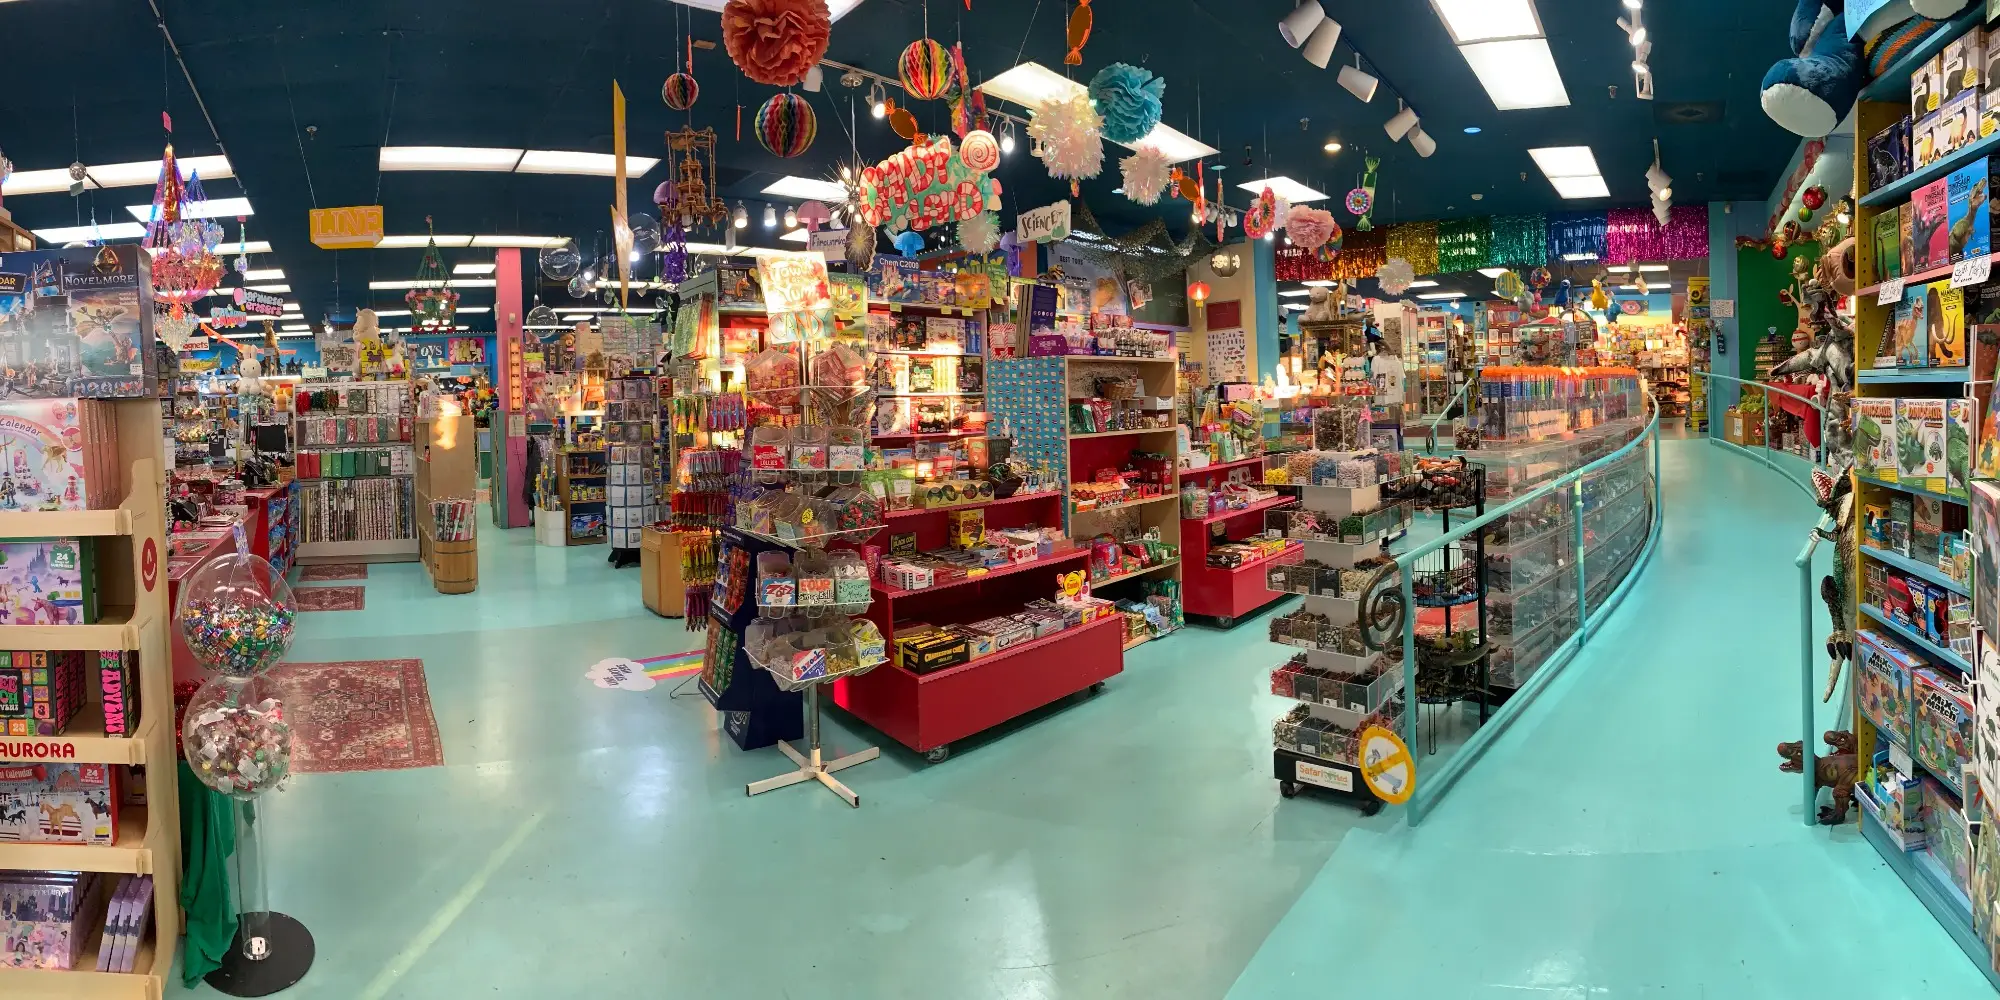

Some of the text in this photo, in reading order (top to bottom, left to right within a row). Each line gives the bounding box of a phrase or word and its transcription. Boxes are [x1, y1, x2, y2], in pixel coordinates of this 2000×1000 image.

[860, 135, 952, 227] CANDY
[910, 179, 984, 231] LAND
[313, 208, 381, 237] LINE
[1020, 209, 1058, 239] SCIENCE
[878, 257, 920, 270] Chem C2000
[1060, 255, 1071, 263] BEST
[65, 274, 136, 287] NOVELMORE
[768, 310, 836, 341] CANDY
[182, 341, 209, 351] agnets
[1908, 406, 1944, 422] DINOSAUR
[56, 552, 69, 561] 24
[1871, 650, 1888, 665] Mix
[1868, 656, 1891, 678] Match
[1931, 692, 1952, 709] Mix
[1926, 699, 1957, 722] Match
[0, 742, 75, 758] AURORA
[6, 768, 33, 779] Calendar
[86, 768, 98, 777] 24
[1299, 764, 1324, 778] Safari
